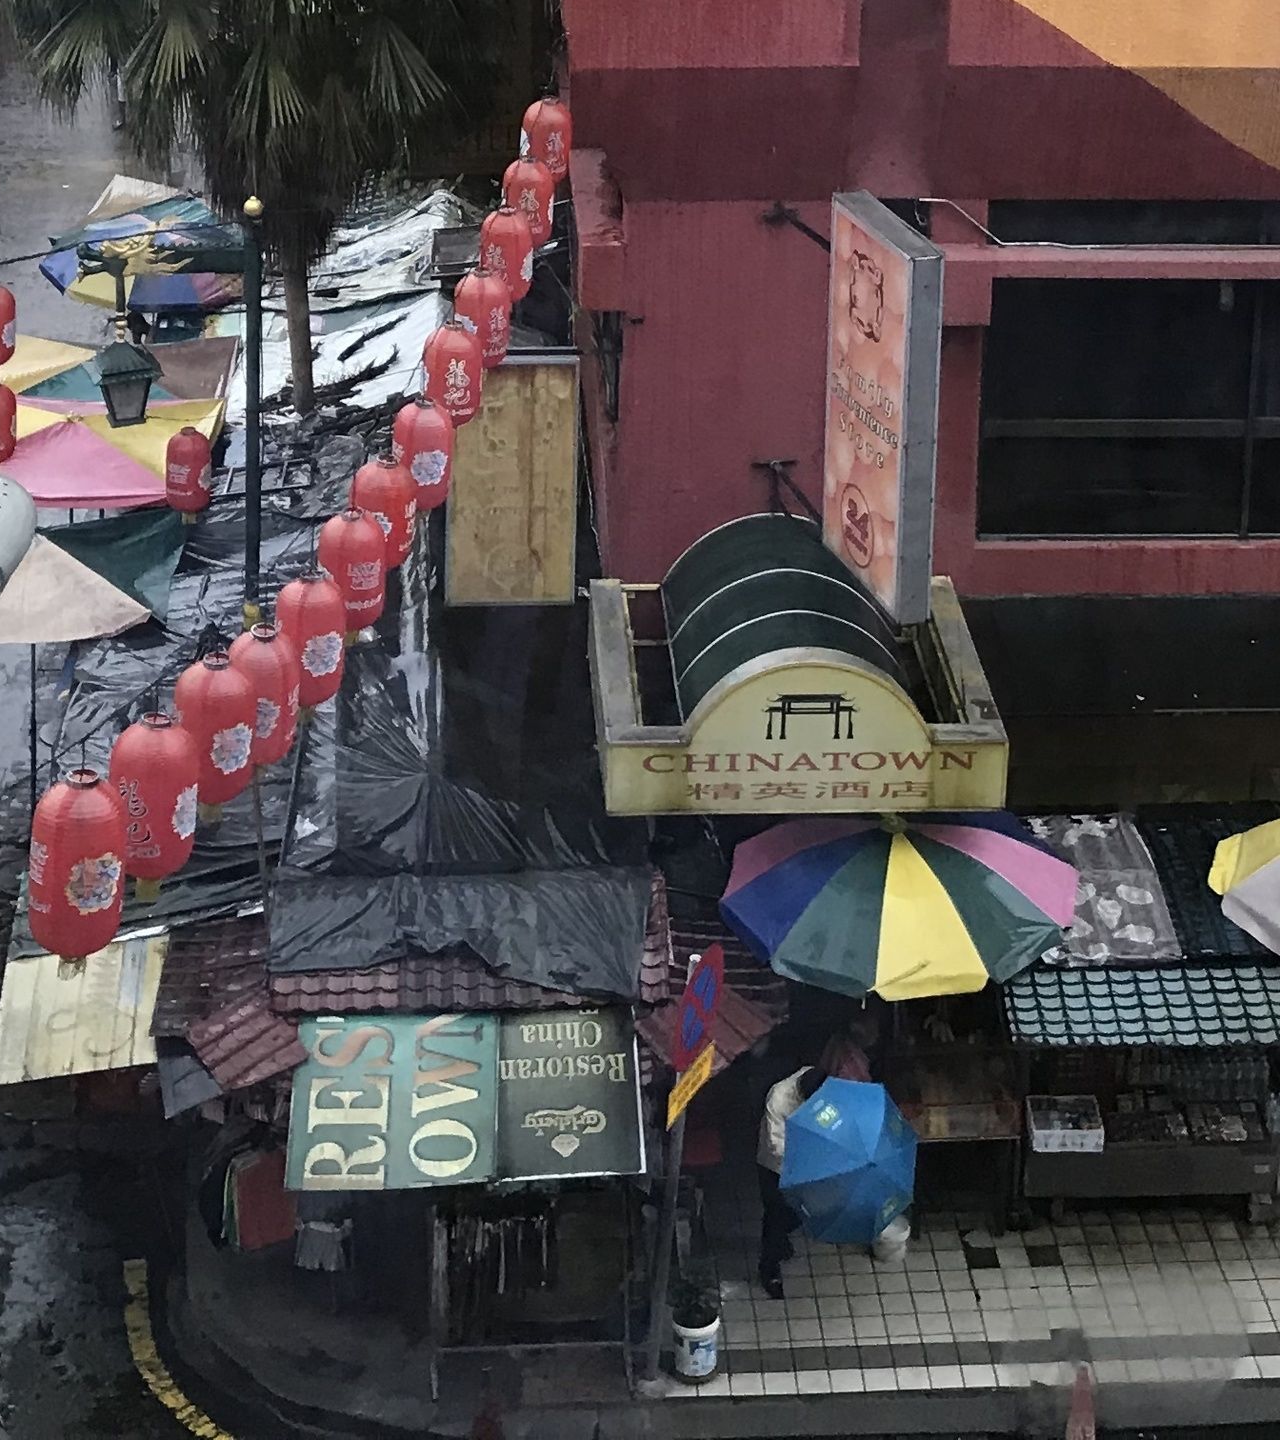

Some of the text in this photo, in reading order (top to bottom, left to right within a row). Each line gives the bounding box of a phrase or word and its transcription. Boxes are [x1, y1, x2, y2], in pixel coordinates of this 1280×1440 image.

[838, 358, 894, 418] Family
[831, 372, 898, 449] Convenience
[839, 412, 884, 469] Store
[642, 751, 977, 773] CHINATOWN
[686, 780, 934, 800] 精英酒店
[520, 1021, 602, 1049] China
[500, 1053, 627, 1081] Restoran
[302, 1016, 395, 1190] RES
[521, 1105, 606, 1136] Carlsberg
